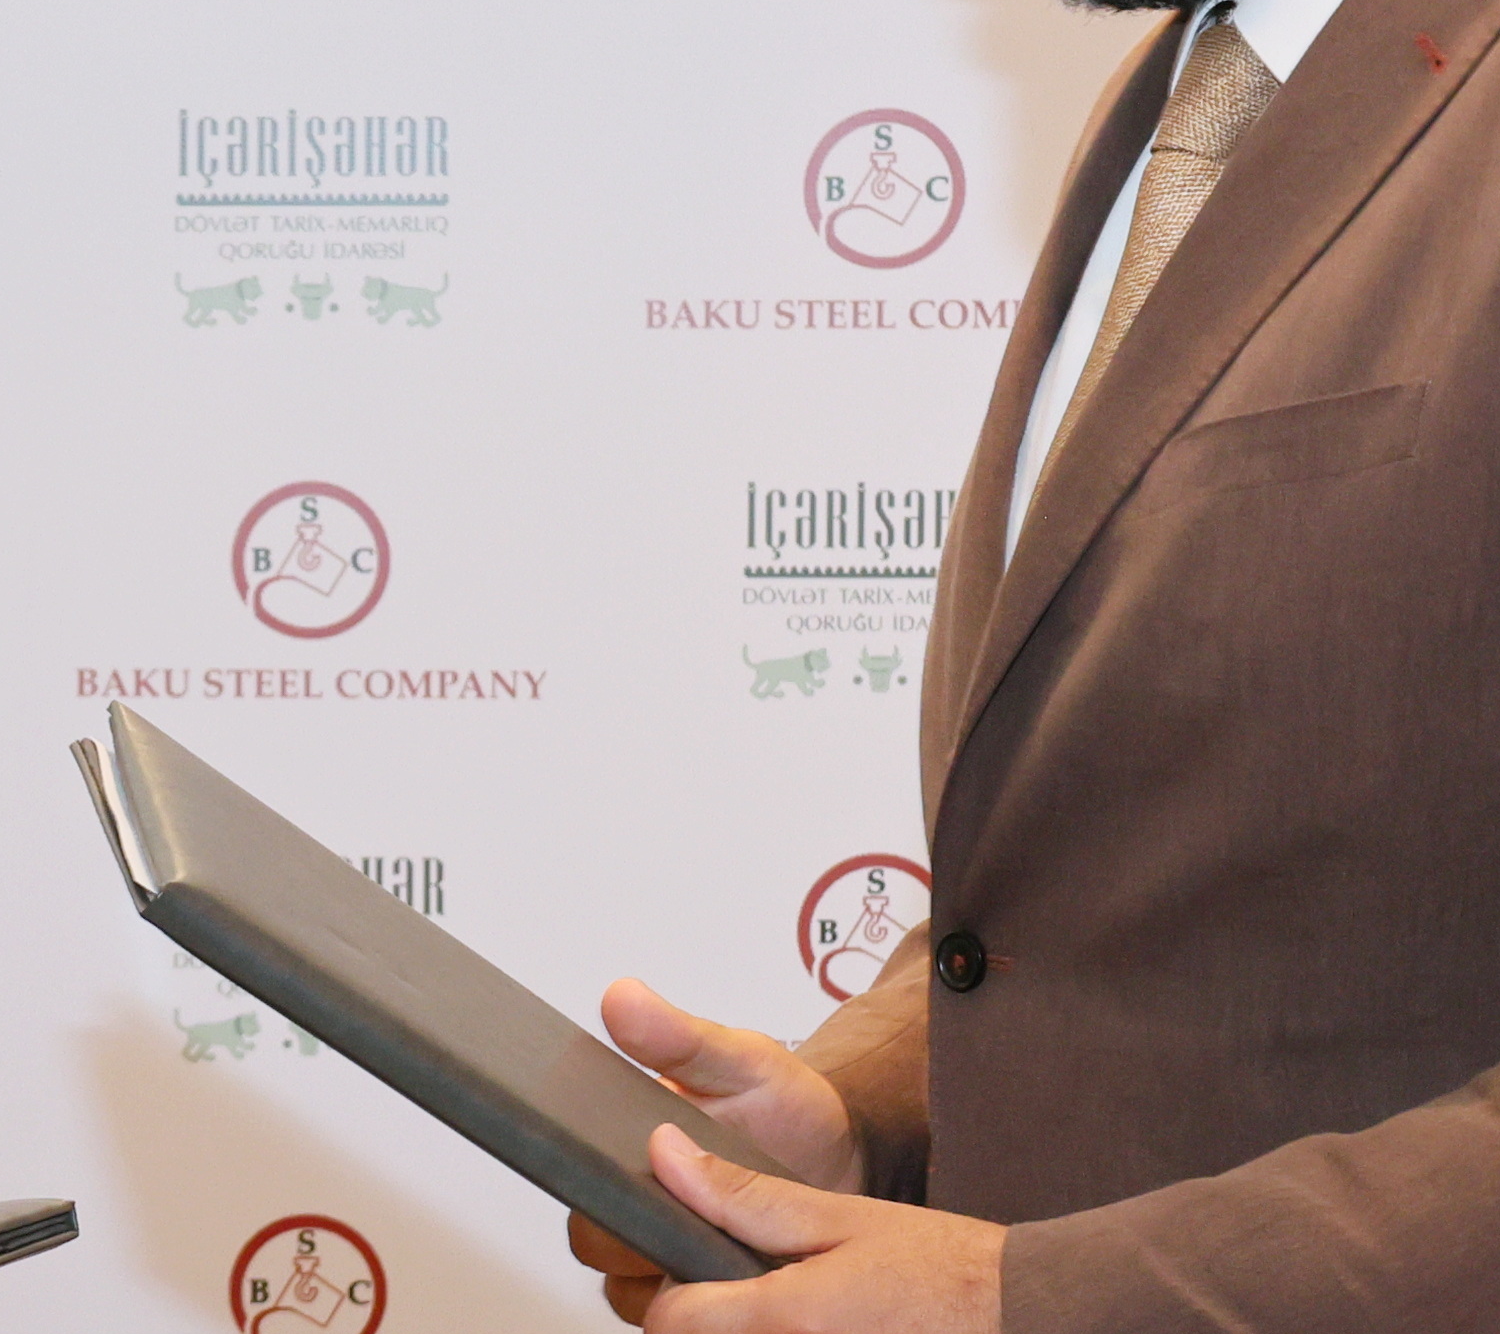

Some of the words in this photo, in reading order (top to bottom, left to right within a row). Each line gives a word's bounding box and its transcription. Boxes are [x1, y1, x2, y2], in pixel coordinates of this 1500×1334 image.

[645, 300, 762, 330] BAKU
[773, 300, 896, 329] STEEL
[301, 497, 318, 522] S
[253, 548, 271, 572] B
[351, 549, 372, 573] C
[77, 668, 189, 699] BAKU
[203, 669, 323, 699] STEEL
[335, 669, 546, 700] COMPANY
[299, 1230, 315, 1254] S
[251, 1280, 269, 1303] B
[348, 1281, 369, 1305] C
